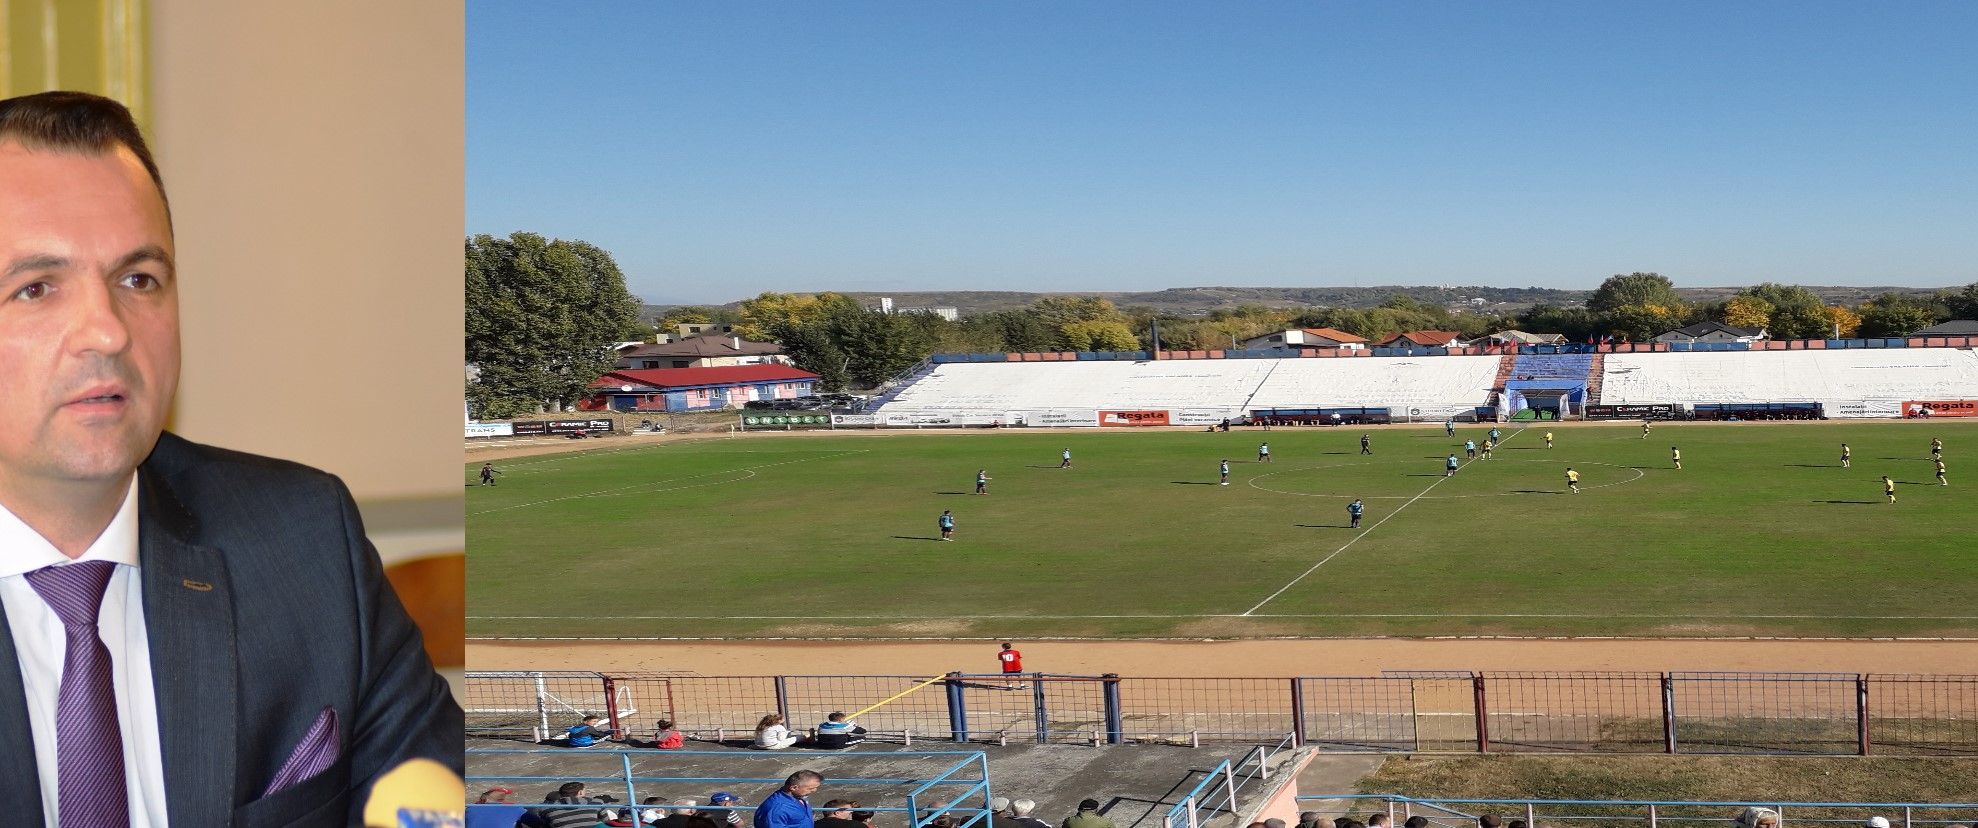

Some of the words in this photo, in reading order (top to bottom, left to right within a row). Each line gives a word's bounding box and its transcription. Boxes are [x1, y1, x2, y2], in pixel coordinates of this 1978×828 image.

[1922, 402, 1974, 411] Regata
[747, 416, 825, 425] UNIBET
[1117, 412, 1164, 420] Regata
